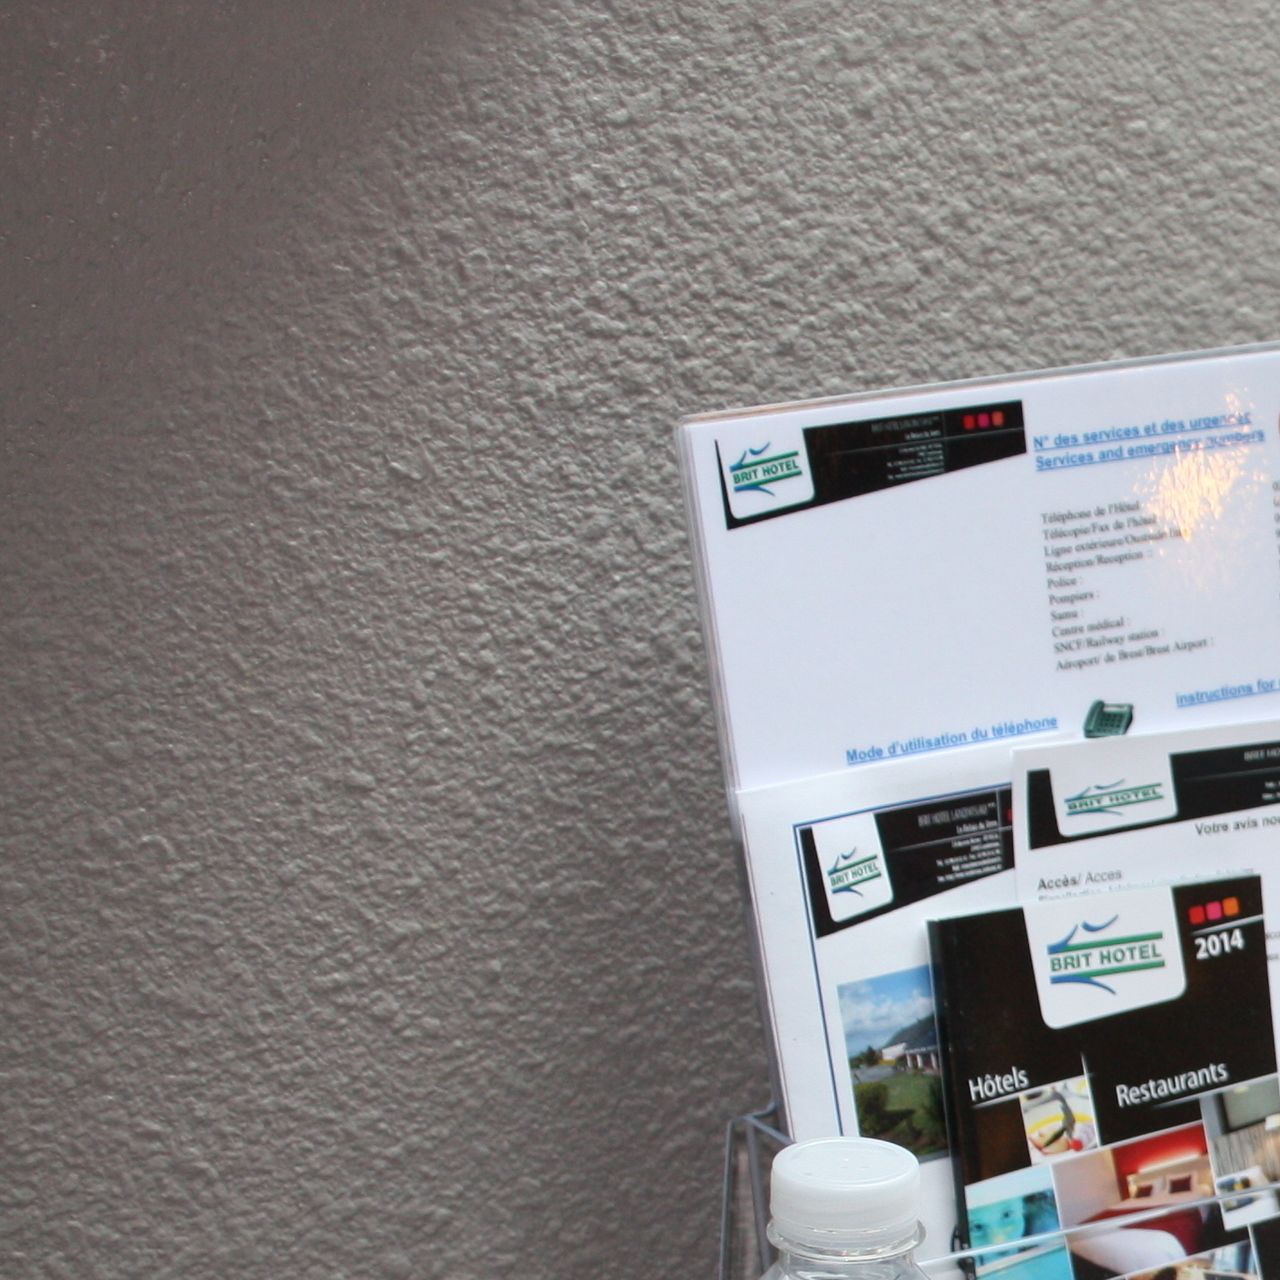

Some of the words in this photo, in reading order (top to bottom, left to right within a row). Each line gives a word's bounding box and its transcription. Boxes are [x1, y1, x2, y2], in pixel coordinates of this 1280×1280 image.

[1054, 432, 1078, 447] des
[1083, 424, 1139, 443] services
[1144, 421, 1157, 435] et
[1161, 418, 1185, 433] des
[1036, 447, 1094, 467] Services
[1099, 442, 1124, 461] and
[733, 467, 759, 485] BRIT
[762, 461, 799, 478] HOTEL
[1047, 576, 1077, 590] Police
[1049, 589, 1094, 606] Pompiers
[1050, 608, 1078, 622] Samu
[1052, 625, 1084, 638] Centre
[1087, 616, 1124, 632] médical
[1128, 628, 1159, 642] station
[1256, 677, 1274, 692] for
[847, 743, 884, 762] Mode
[886, 732, 967, 757] d'utilisation
[971, 726, 988, 741] du
[991, 716, 1058, 738] téléphone
[1107, 788, 1160, 806] HOTEL
[1194, 821, 1229, 836] Votre
[1232, 816, 1259, 831] avis
[830, 872, 850, 888] BRIT
[852, 864, 879, 880] HOTEL
[1194, 928, 1244, 960] 2014
[1050, 952, 1093, 972] BRIT
[1099, 943, 1163, 965] HOTEL
[968, 1065, 1031, 1102] Hôtels
[1115, 1062, 1230, 1108] Restaurants
